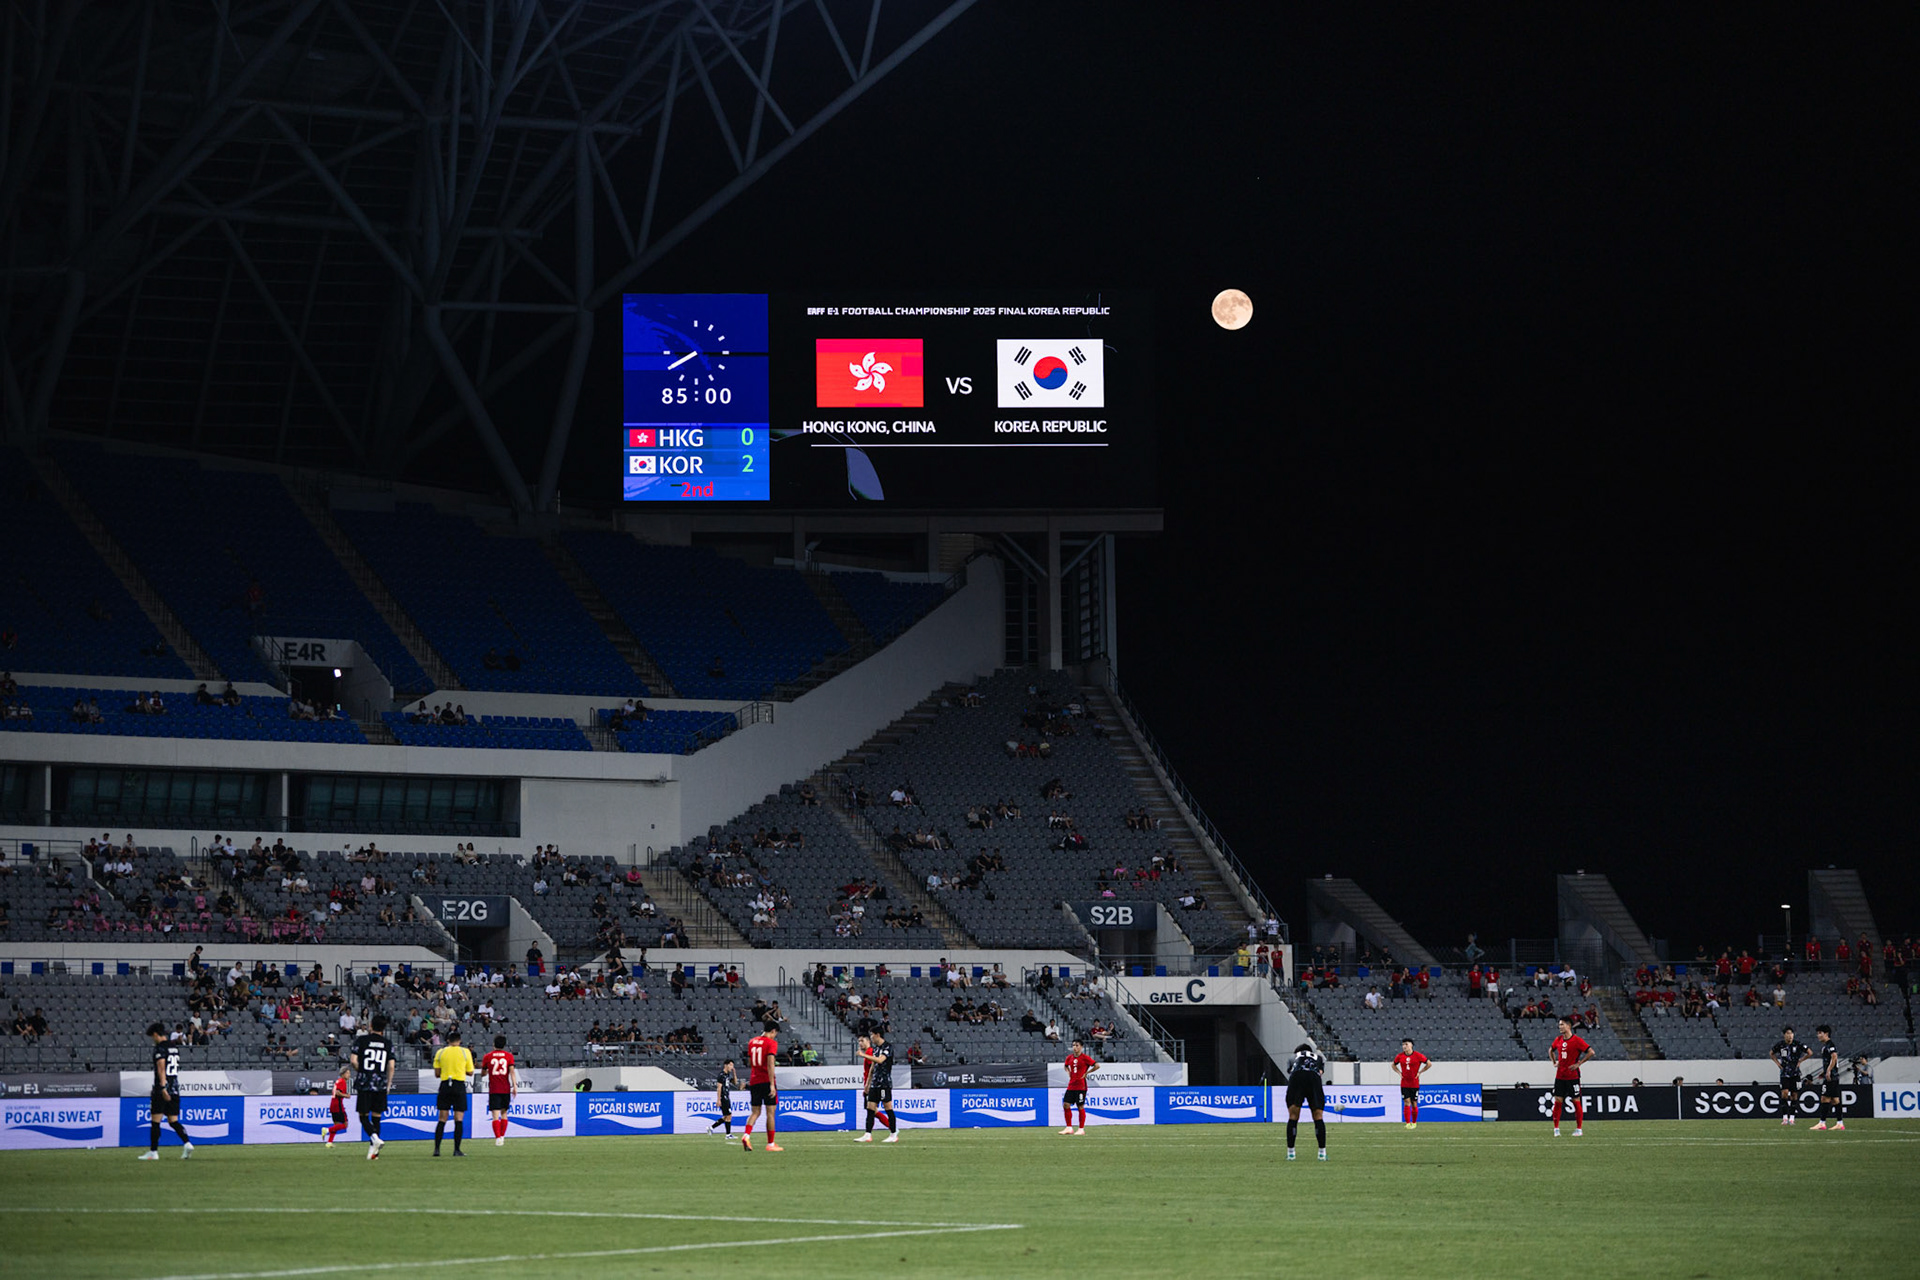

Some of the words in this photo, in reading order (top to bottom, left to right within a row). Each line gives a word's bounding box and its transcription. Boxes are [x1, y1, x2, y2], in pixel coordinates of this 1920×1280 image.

[842, 307, 894, 316] FOOTBALL
[895, 307, 971, 316] CHAMPIONSHIP
[973, 307, 996, 316] 2025
[998, 307, 1026, 316] FINAL
[1028, 307, 1061, 316] KOREA
[1062, 307, 1111, 316] REPUBLIC
[946, 377, 973, 394] VS
[661, 388, 732, 404] 85:00
[803, 421, 844, 434] HONG
[847, 421, 890, 435] KONG,
[892, 421, 936, 433] CHINA
[994, 421, 1039, 433] KOREA
[1042, 420, 1107, 433] REPUBLIC
[659, 429, 704, 447] HKG
[741, 428, 754, 446] 0
[659, 456, 704, 474] KOR
[742, 455, 754, 473] 2
[681, 481, 714, 498] 2nd
[284, 642, 326, 661] E4R
[442, 900, 488, 920] E2G
[1090, 906, 1134, 926] S2B
[1150, 992, 1183, 1004] GATE
[1186, 979, 1206, 1003] C
[364, 1049, 387, 1072] 24
[751, 1046, 764, 1067] 11
[491, 1058, 508, 1076] 23
[800, 1077, 851, 1086] INNOVATION
[1131, 1073, 1156, 1081] UNITY
[23, 1083, 40, 1094] E-1
[215, 1083, 242, 1091] UNITY
[904, 1098, 937, 1109] SWEAT
[962, 1098, 999, 1108] POCARI
[1000, 1097, 1035, 1107] SWEAT
[1102, 1096, 1139, 1106] SWEAT
[1169, 1095, 1211, 1105] POCARI
[1214, 1095, 1254, 1105] SWEAT
[1340, 1095, 1384, 1104] SWEAT
[1418, 1094, 1462, 1104] POCARI
[1564, 1095, 1639, 1113] SFIDA
[1759, 1091, 1857, 1113] GOP
[383, 1106, 418, 1117] OCARI
[527, 1103, 562, 1115] SWEAT
[588, 1102, 626, 1114] POCARI
[627, 1102, 661, 1113] SWEAT
[779, 1100, 812, 1111] POCARI
[813, 1100, 845, 1110] SWEAT
[5, 1111, 54, 1123] POCARI
[58, 1110, 102, 1122] SWEAT
[186, 1108, 228, 1120] SWEAT
[260, 1107, 304, 1119] POCARI
[306, 1107, 331, 1119] SWE
